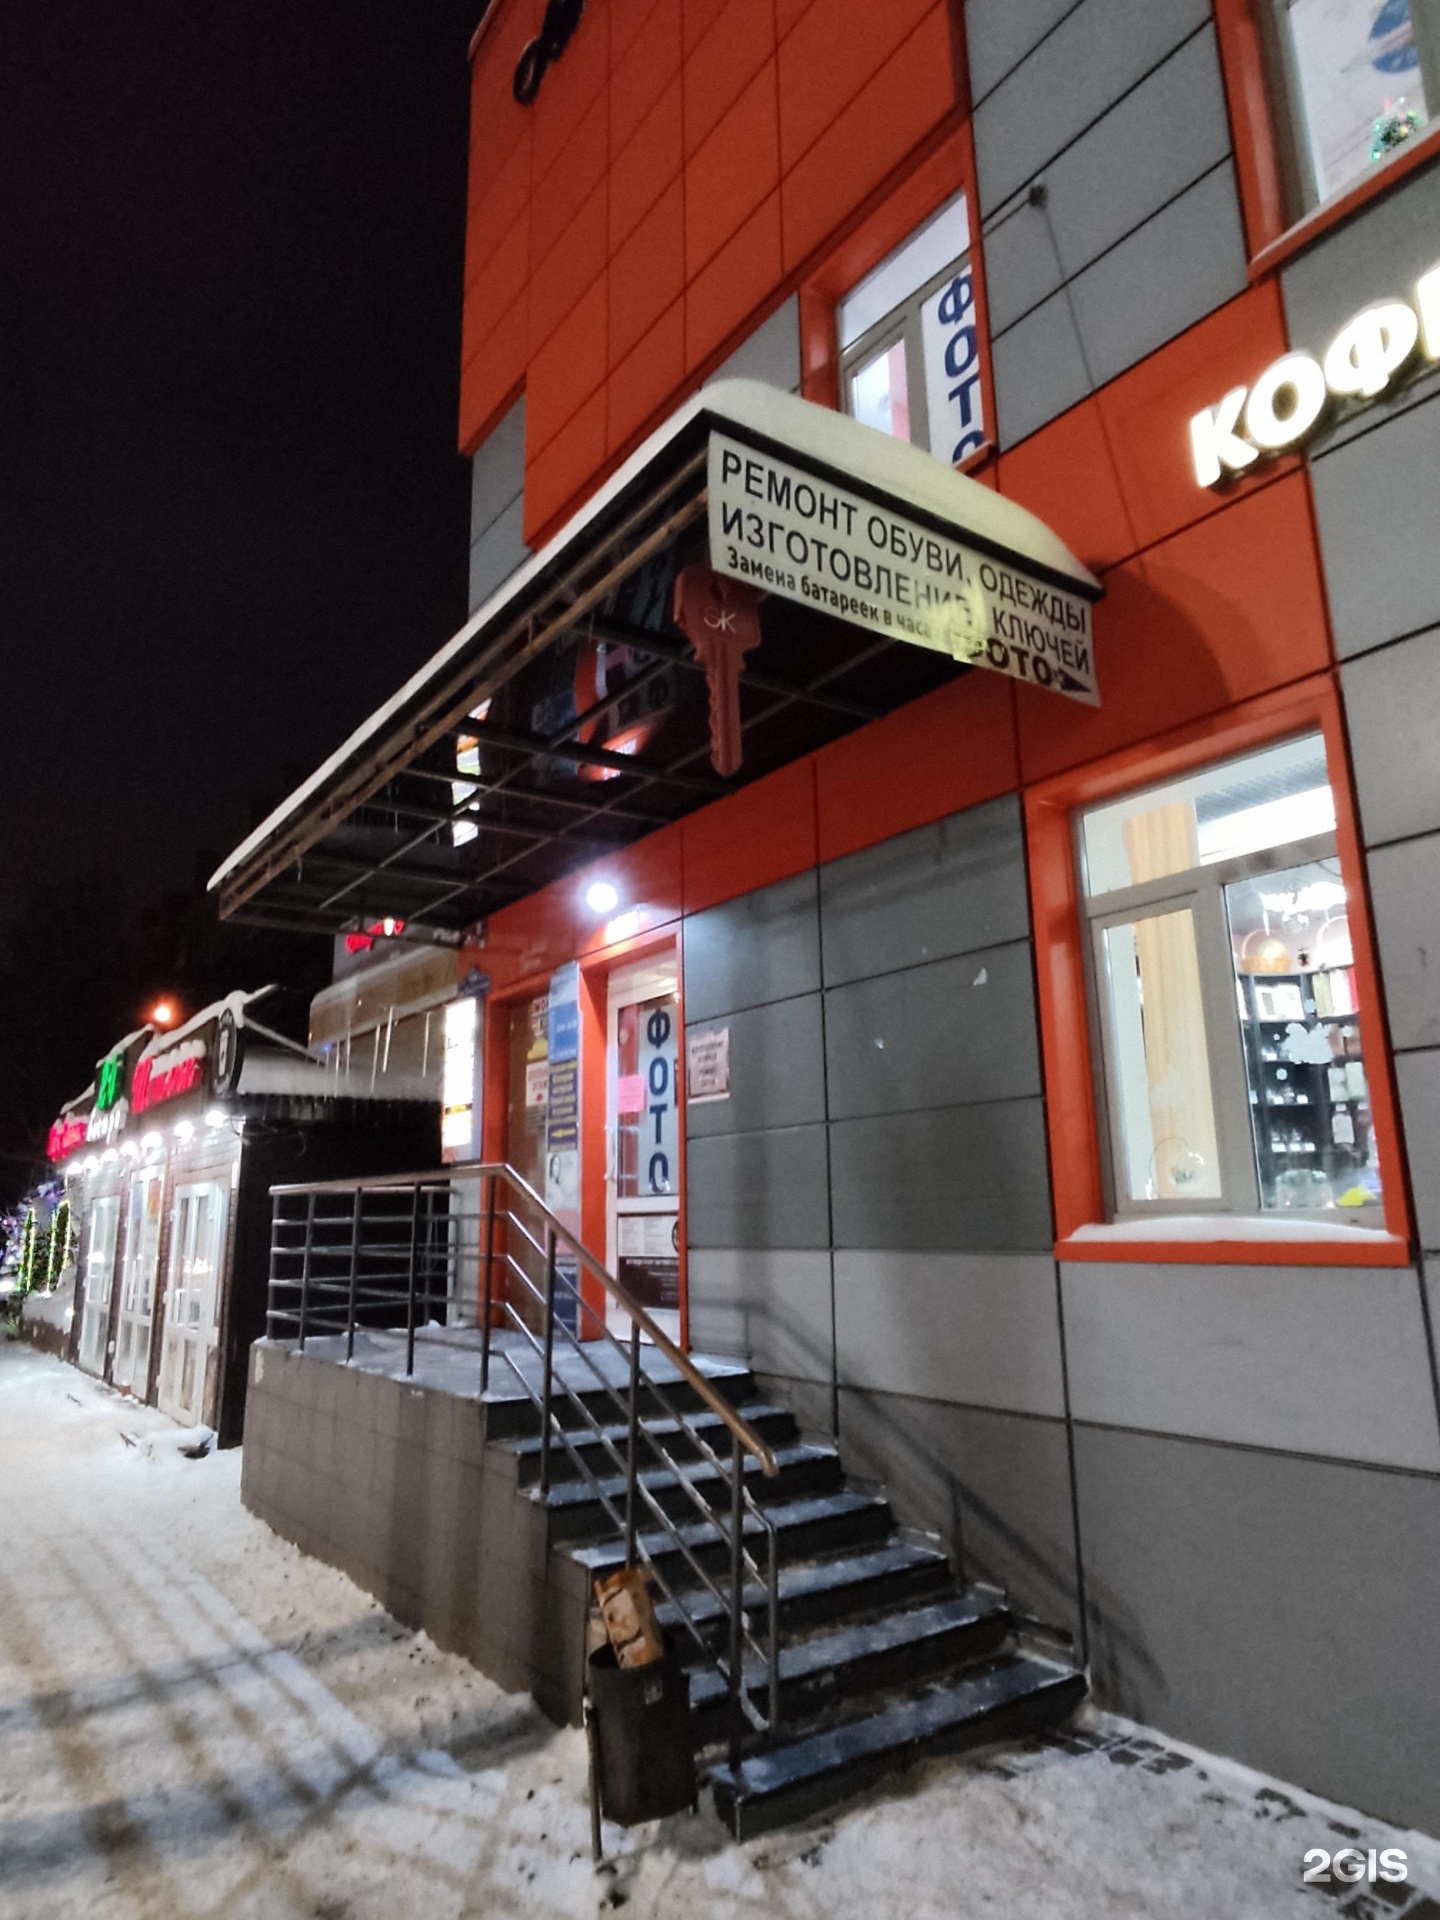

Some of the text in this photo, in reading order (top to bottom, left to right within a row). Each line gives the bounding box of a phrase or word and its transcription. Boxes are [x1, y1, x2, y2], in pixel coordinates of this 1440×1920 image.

[722, 449, 1086, 634] РЕМОНТ ОБУВИ, ОДЕЖДЫ
[727, 545, 796, 591] Замена
[800, 575, 879, 622] батареек
[883, 609, 893, 627] в
[992, 606, 1090, 675] КЛЮЧЕЙ
[646, 1007, 670, 1193] ФОТО
